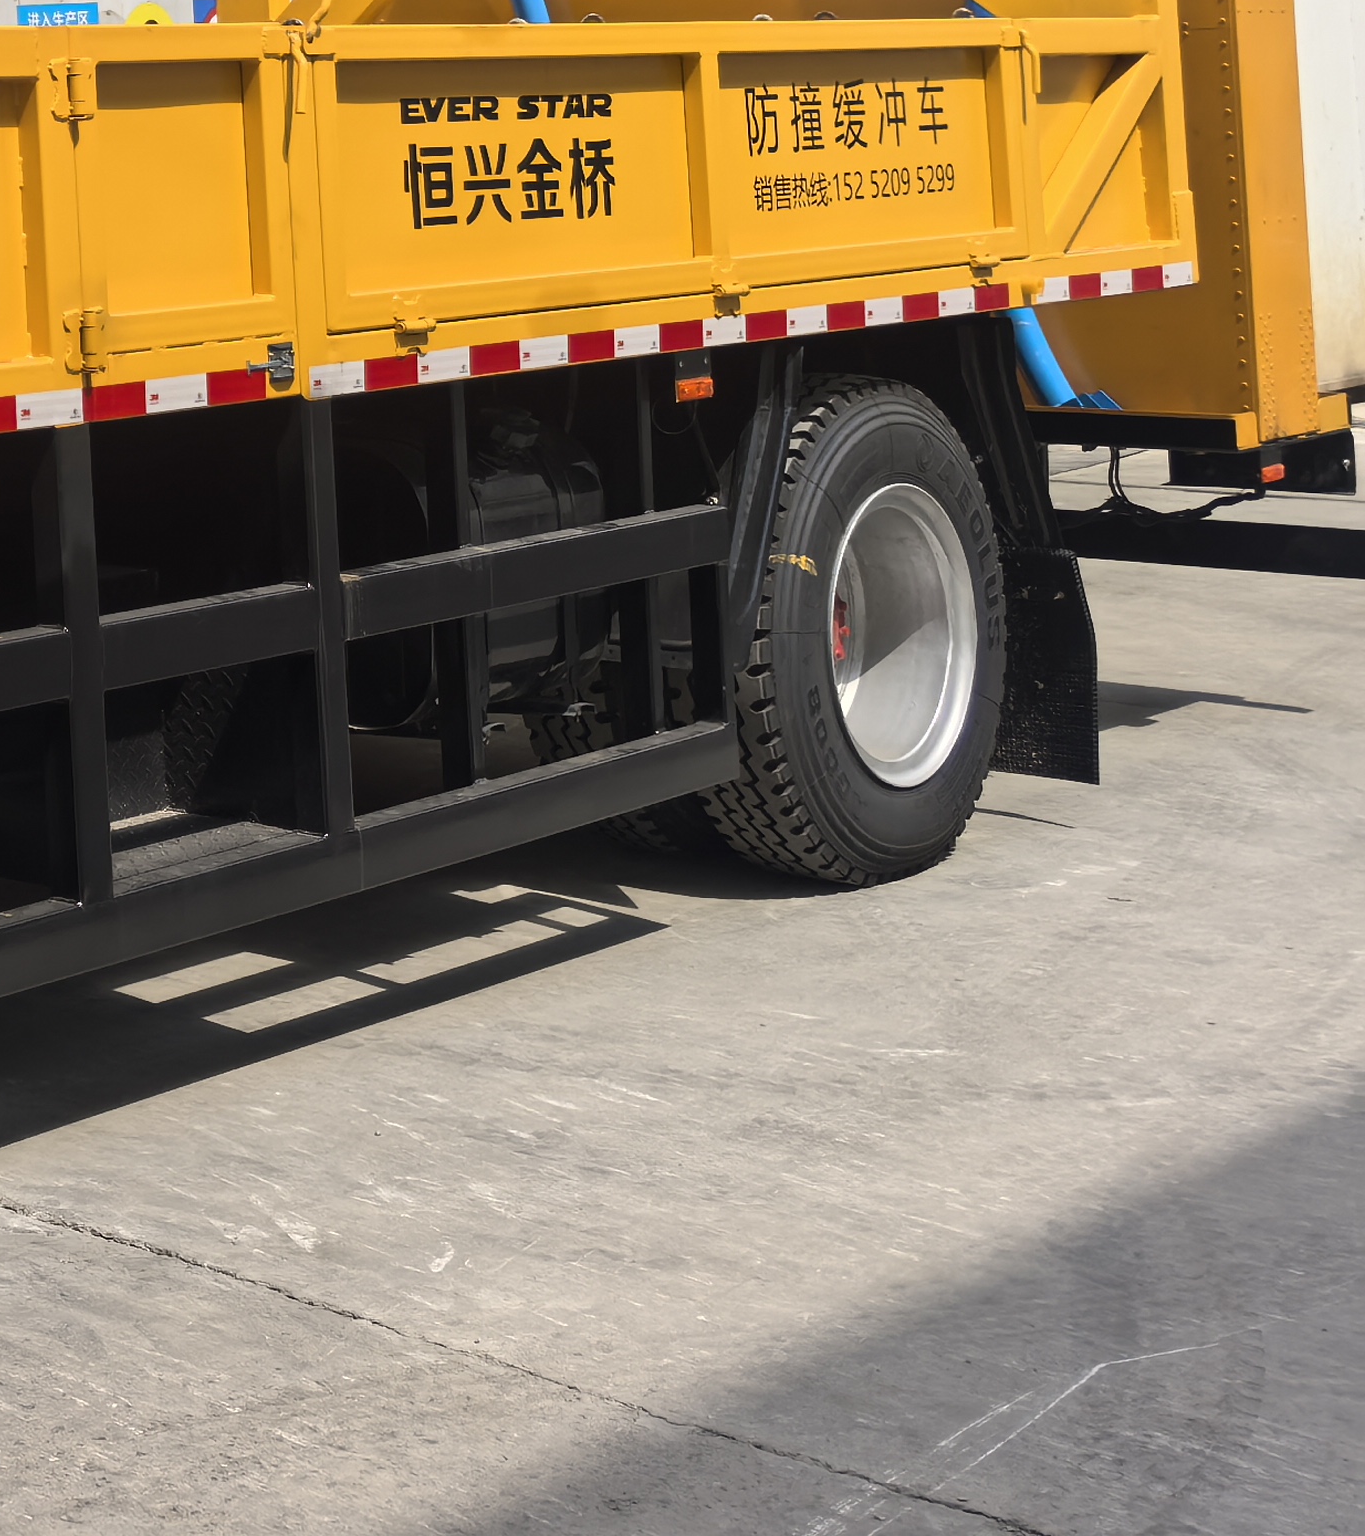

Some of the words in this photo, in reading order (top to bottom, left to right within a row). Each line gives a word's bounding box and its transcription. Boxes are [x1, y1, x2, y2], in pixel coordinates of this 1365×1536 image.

[400, 95, 499, 124] EVER
[516, 93, 612, 120] STAR
[744, 77, 949, 157] 防撞缓冲车
[403, 138, 615, 229] 恒兴金桥
[871, 167, 911, 199] 5209
[916, 163, 955, 195] 5299
